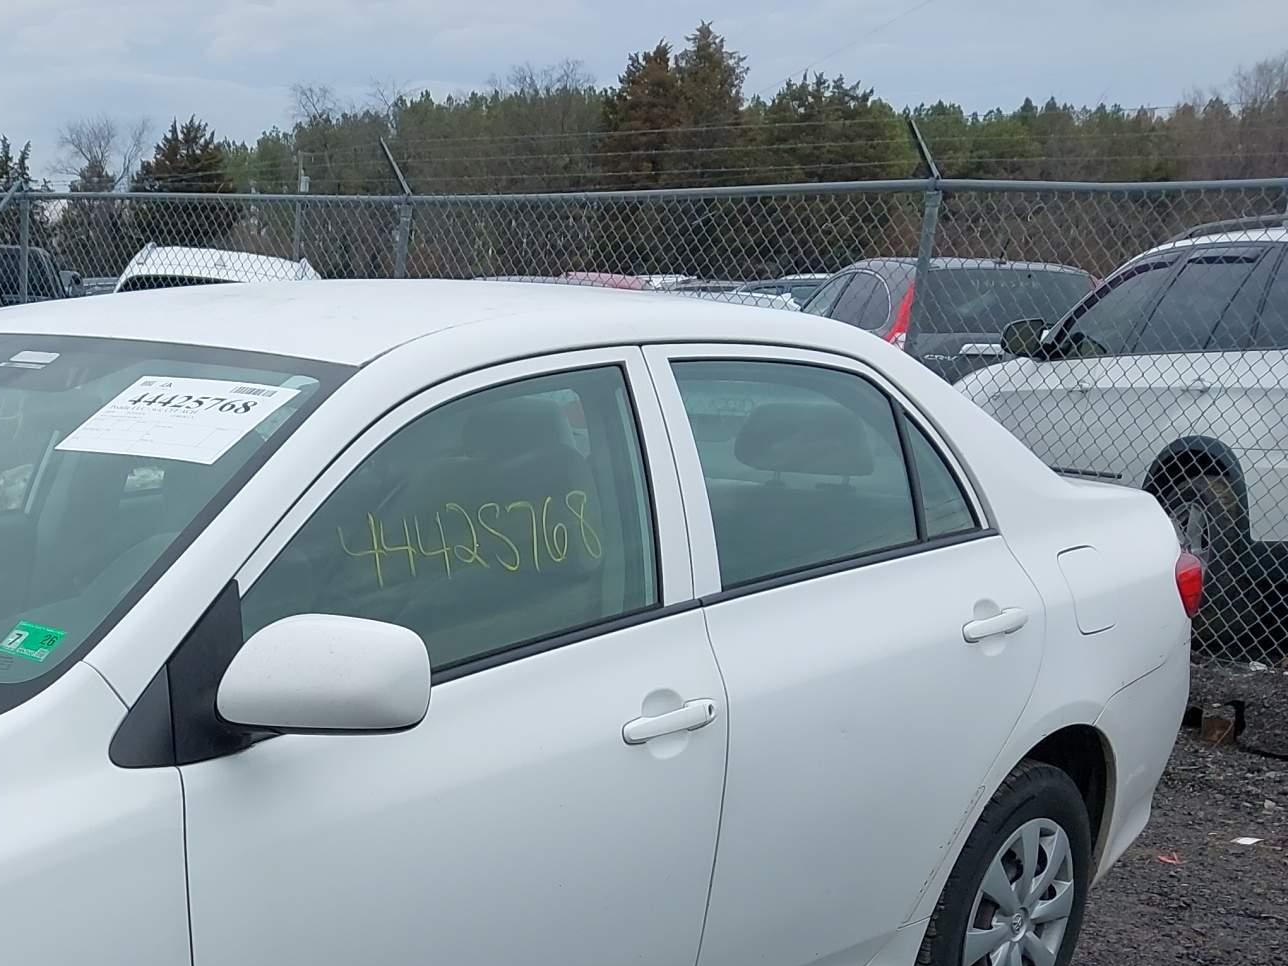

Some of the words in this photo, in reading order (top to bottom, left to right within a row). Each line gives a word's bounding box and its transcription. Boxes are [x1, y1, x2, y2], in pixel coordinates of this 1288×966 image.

[128, 391, 258, 415] 44425768
[336, 489, 603, 589] 44425768
[8, 633, 23, 646] 7
